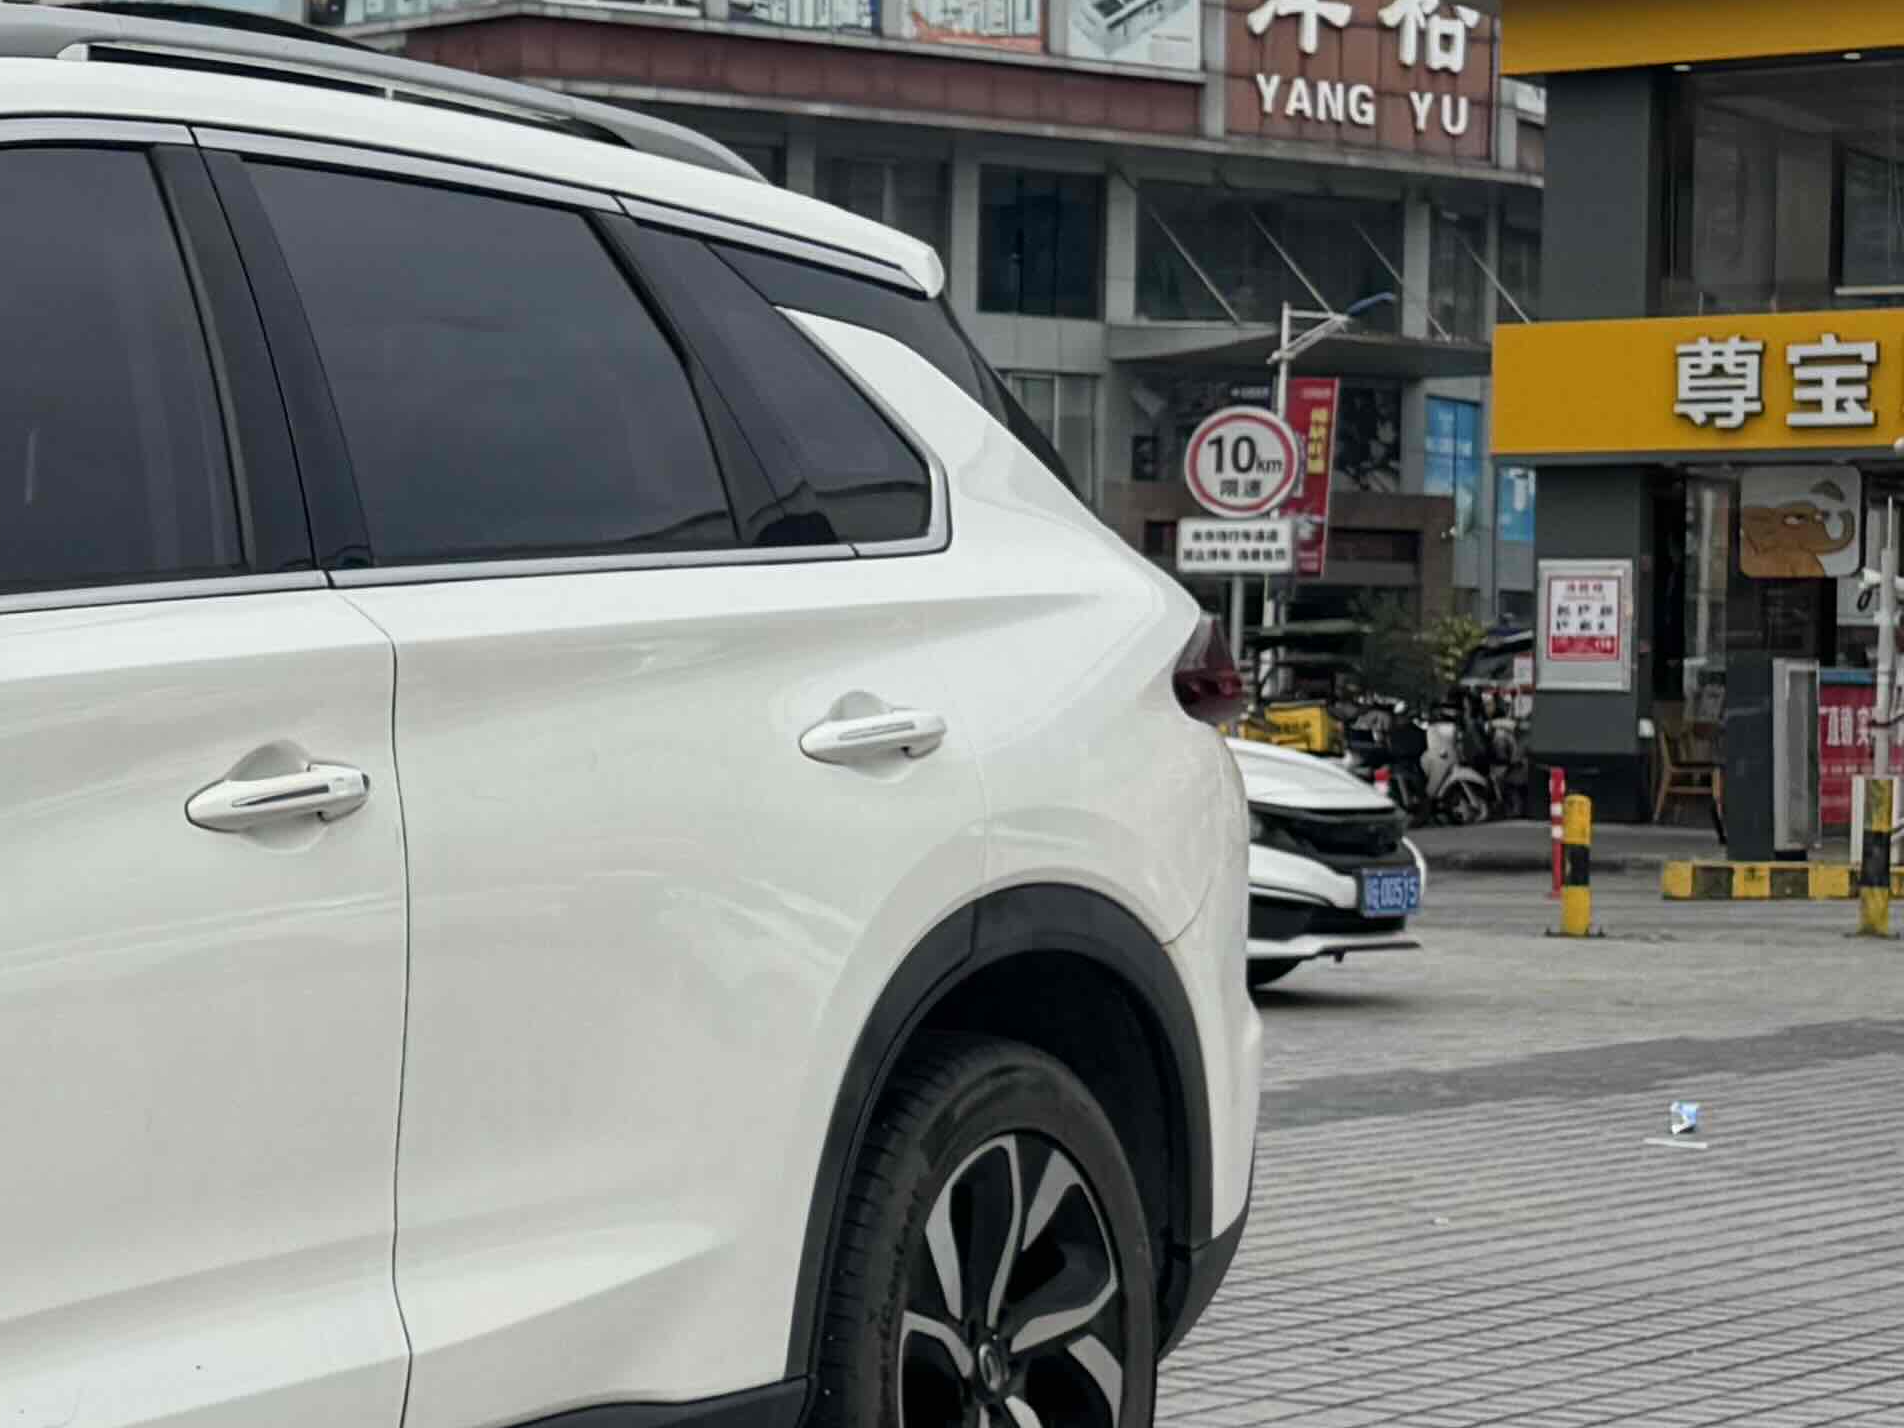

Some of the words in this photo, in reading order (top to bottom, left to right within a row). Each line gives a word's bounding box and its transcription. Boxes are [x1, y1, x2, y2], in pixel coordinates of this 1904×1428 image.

[1255, 73, 1376, 126] YANG
[1409, 91, 1469, 135] YU
[1673, 334, 1878, 429] 尊宝
